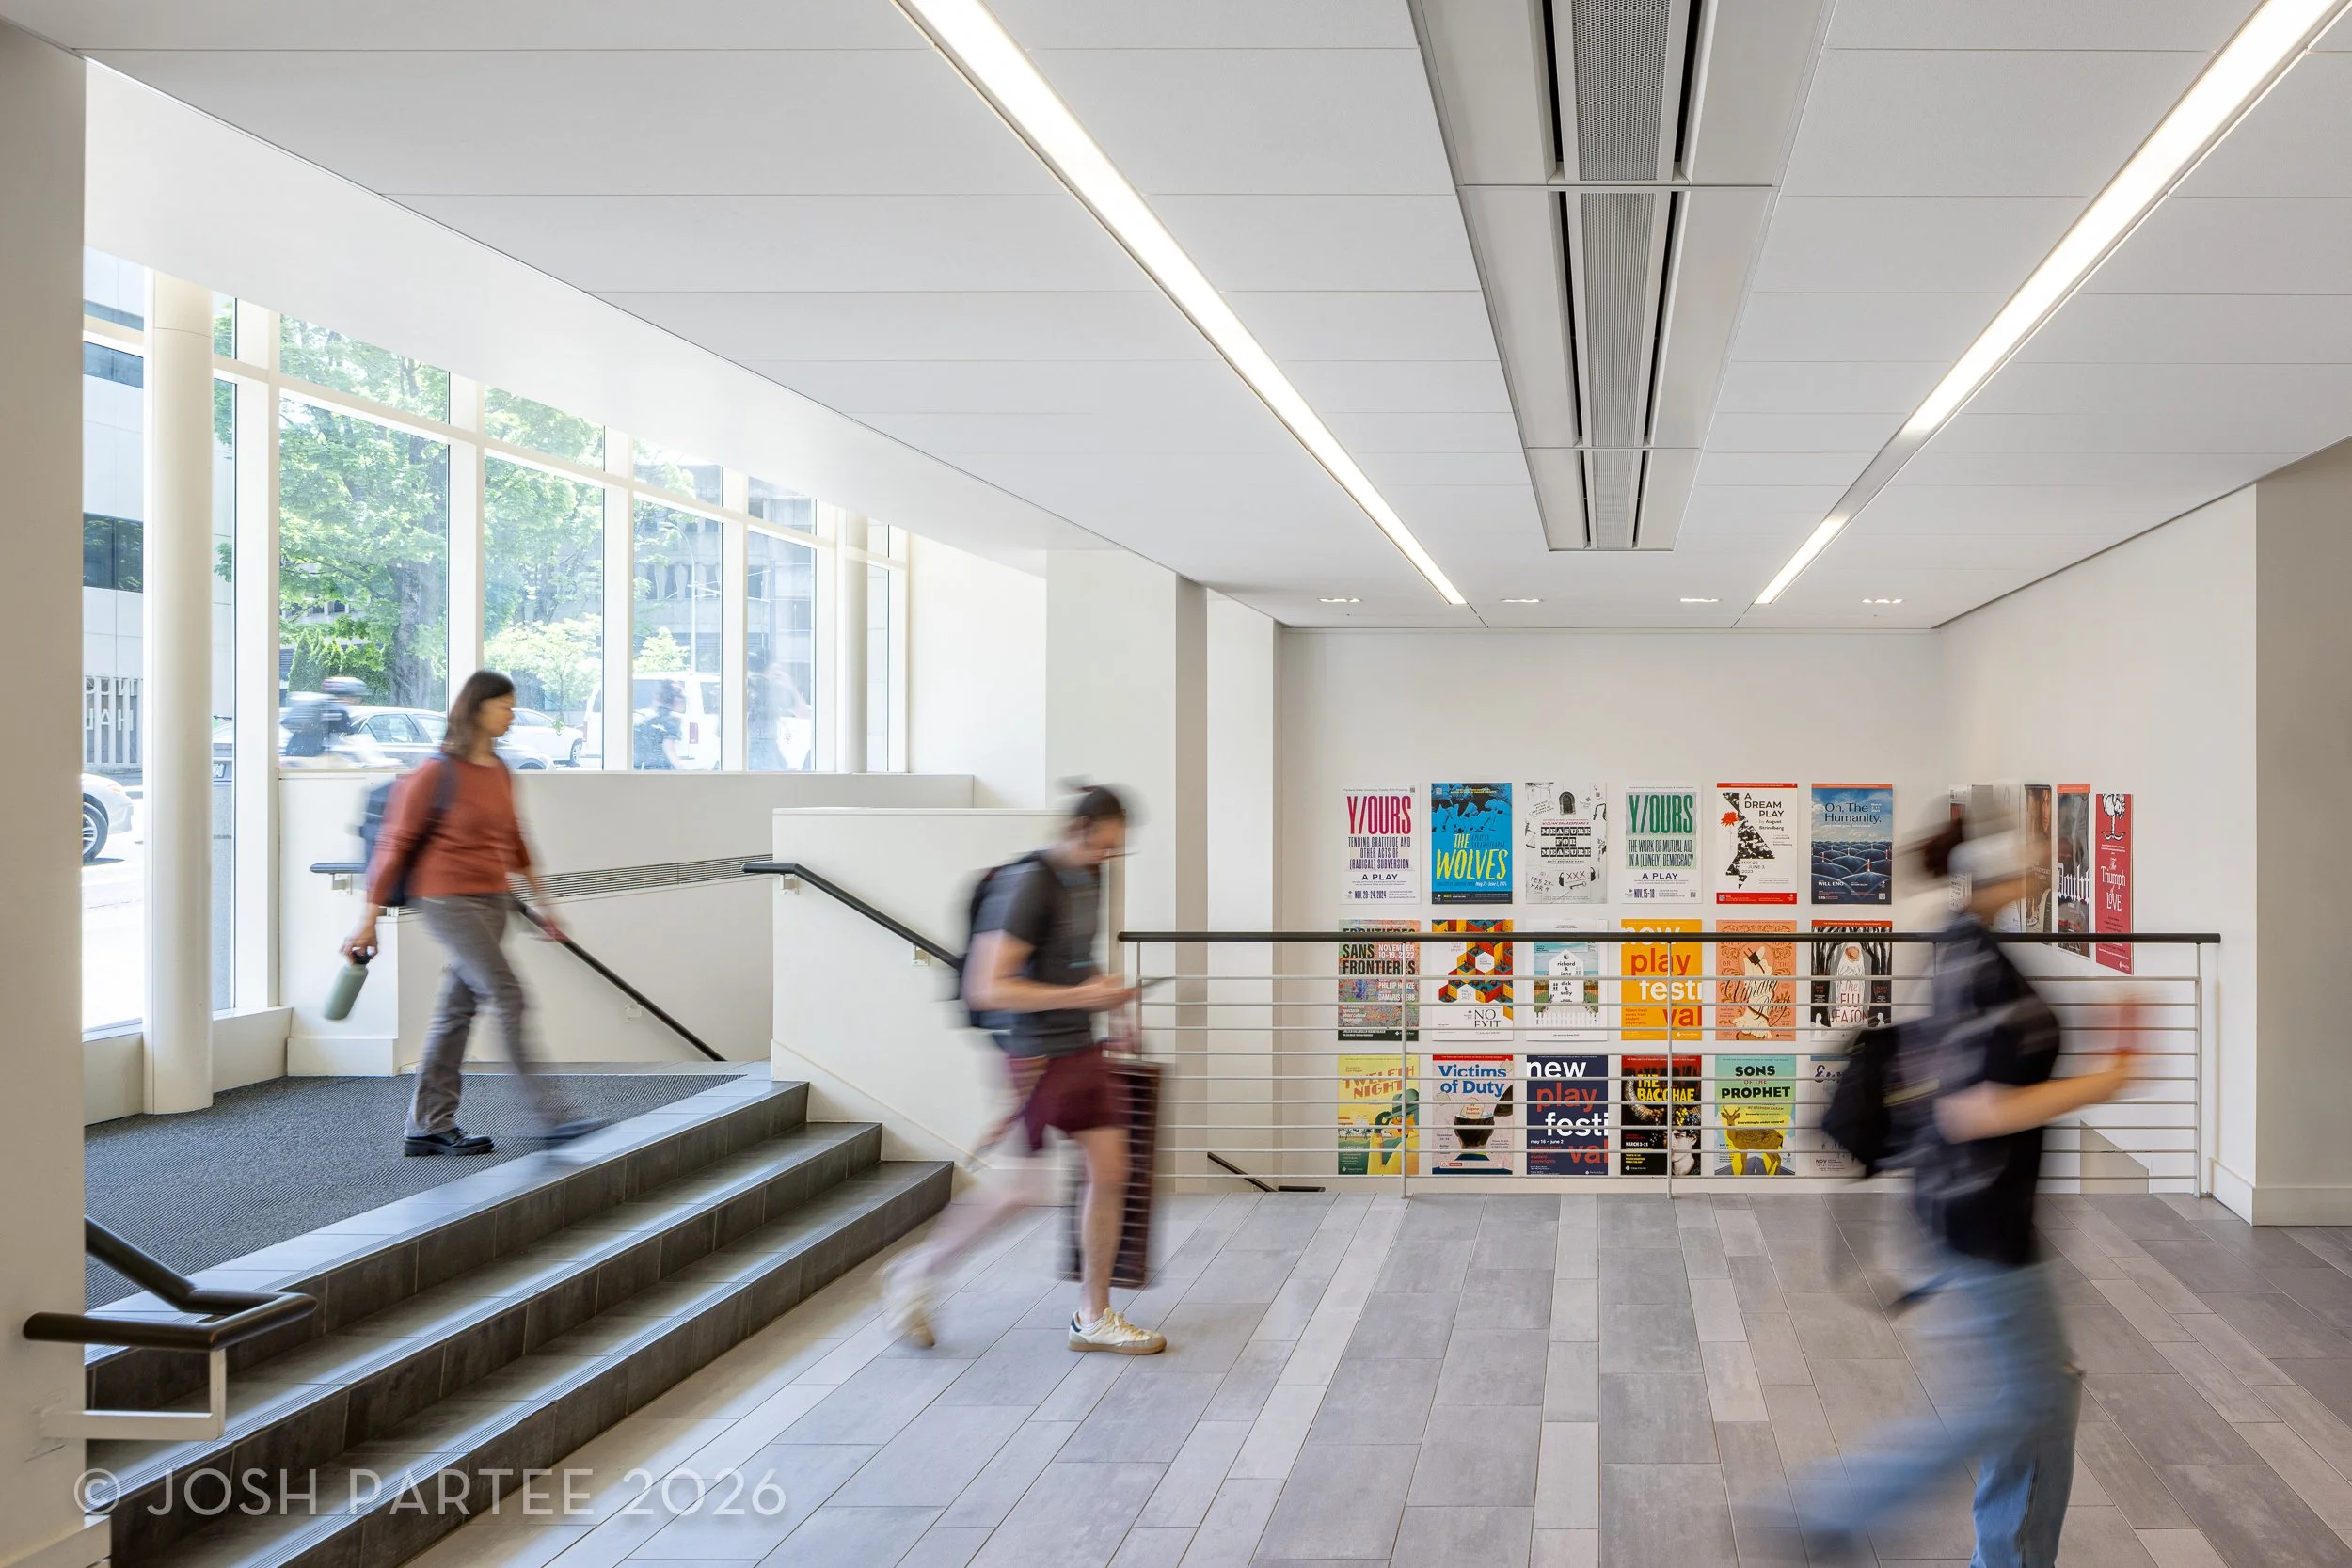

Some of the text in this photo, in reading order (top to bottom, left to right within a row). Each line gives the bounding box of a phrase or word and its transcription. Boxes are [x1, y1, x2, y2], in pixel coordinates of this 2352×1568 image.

[1629, 795, 1693, 833] Y/OURS
[1825, 803, 1844, 813] Oh,
[1846, 803, 1868, 812] The
[1347, 796, 1411, 834] Y/OURS
[1825, 814, 1882, 824] Humanity,
[1541, 827, 1591, 836] MEASURE
[1348, 837, 1411, 847] TENDING GRATITUDE AND
[1454, 834, 1470, 848] THE
[1556, 837, 1576, 847] FOR
[1629, 840, 1693, 852] THE WORK OF MUTUAL AID
[1360, 848, 1399, 858] OTHER ACTS OF
[1541, 847, 1591, 857] MEASURE
[1377, 859, 1409, 869] SUBVERSION
[1437, 849, 1508, 879] WOLVES
[1629, 854, 1634, 866] IN
[1636, 854, 1639, 866] A
[1663, 854, 1693, 866] DEMOCRACY
[2100, 866, 2126, 889] Triumph
[1343, 944, 1374, 958] SANS
[1631, 948, 1691, 976] play
[1841, 980, 1858, 992] The
[1840, 993, 1860, 1007] FLU
[1474, 1009, 1496, 1020] NO
[1830, 1009, 1868, 1023] SEASON
[1438, 1064, 1506, 1077] Victims
[1527, 1061, 1586, 1078] new
[1735, 1066, 1775, 1077] SONS
[1638, 1074, 1660, 1087] THE
[1354, 1079, 1403, 1099] NIGHT
[1440, 1080, 1504, 1098] of Duty
[1722, 1086, 1790, 1099] PROPHET
[1537, 1082, 1597, 1112] play
[1545, 1112, 1608, 1137] festi
[1568, 1139, 1608, 1164] val
